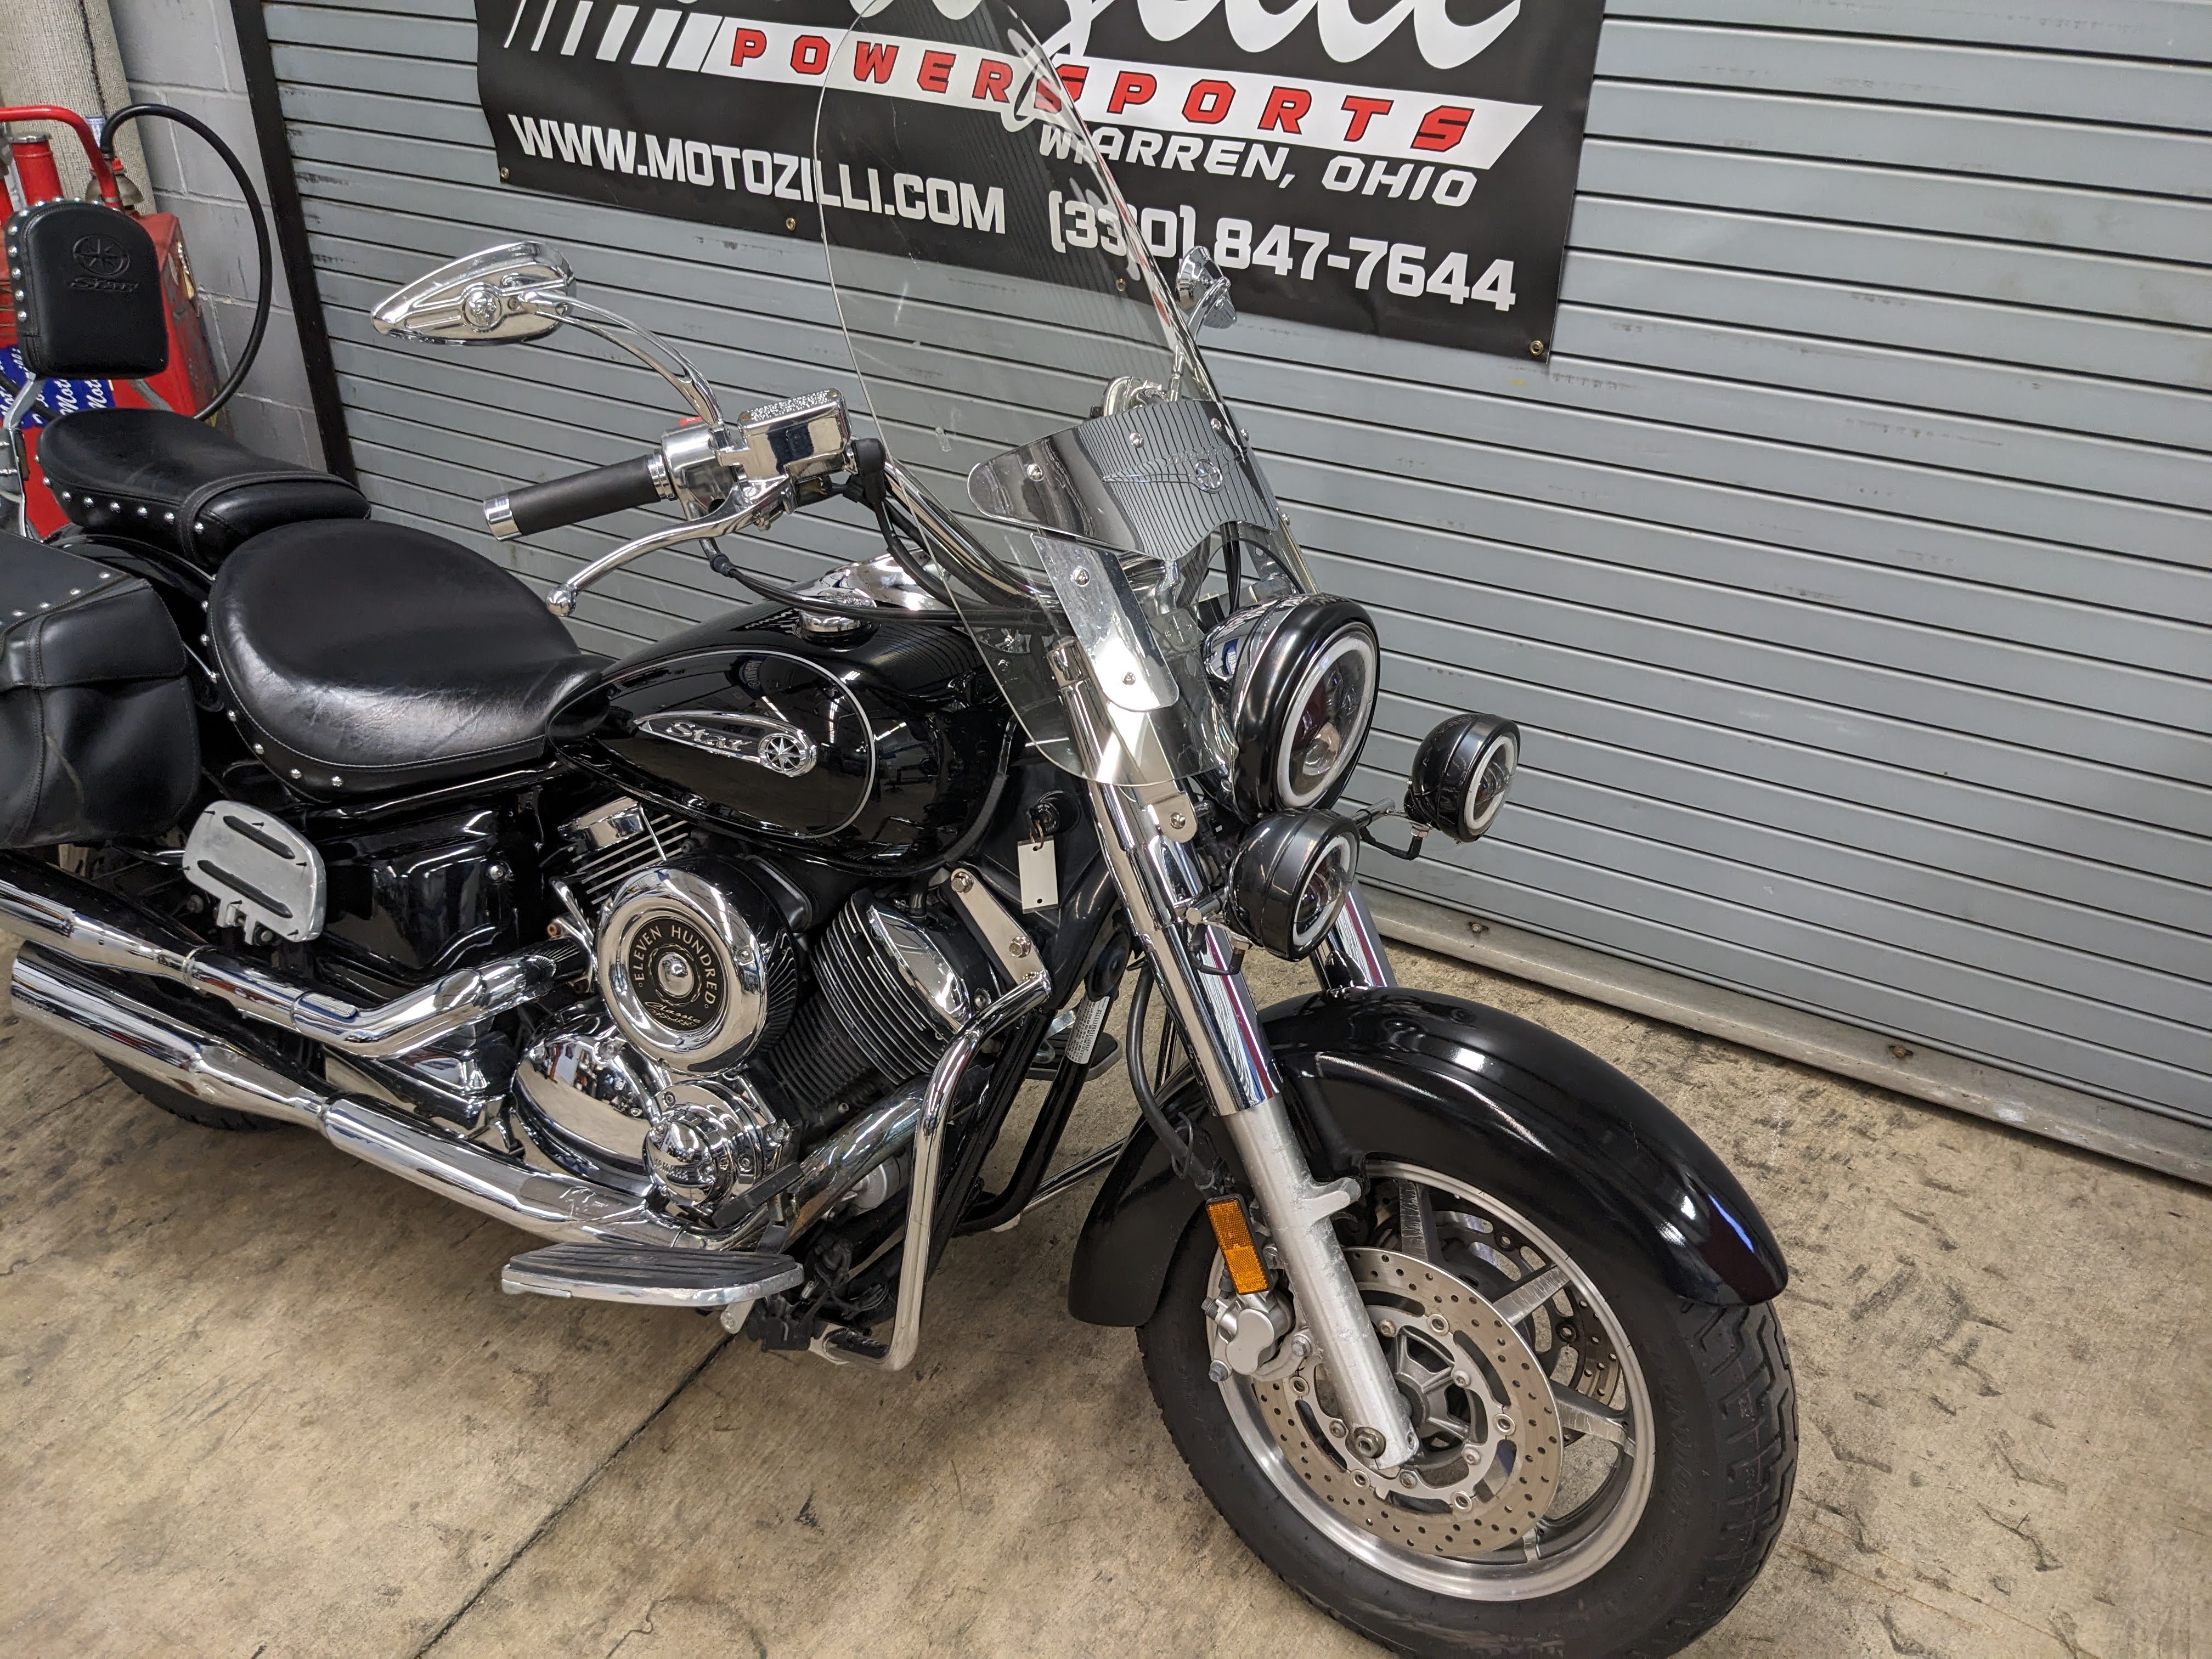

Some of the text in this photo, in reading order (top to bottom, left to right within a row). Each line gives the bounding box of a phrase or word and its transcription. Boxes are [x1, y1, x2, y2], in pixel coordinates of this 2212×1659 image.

[729, 26, 1472, 152] POWERSPORTS
[507, 114, 1006, 234] WWW.MOTOZILLI.COM
[1322, 156, 1477, 207] OHIO
[1214, 218, 1516, 312] 847-7644
[665, 720, 752, 752] Star
[634, 924, 717, 1004] ELEVEN HUNDRED
[644, 1001, 701, 1024] Classic
